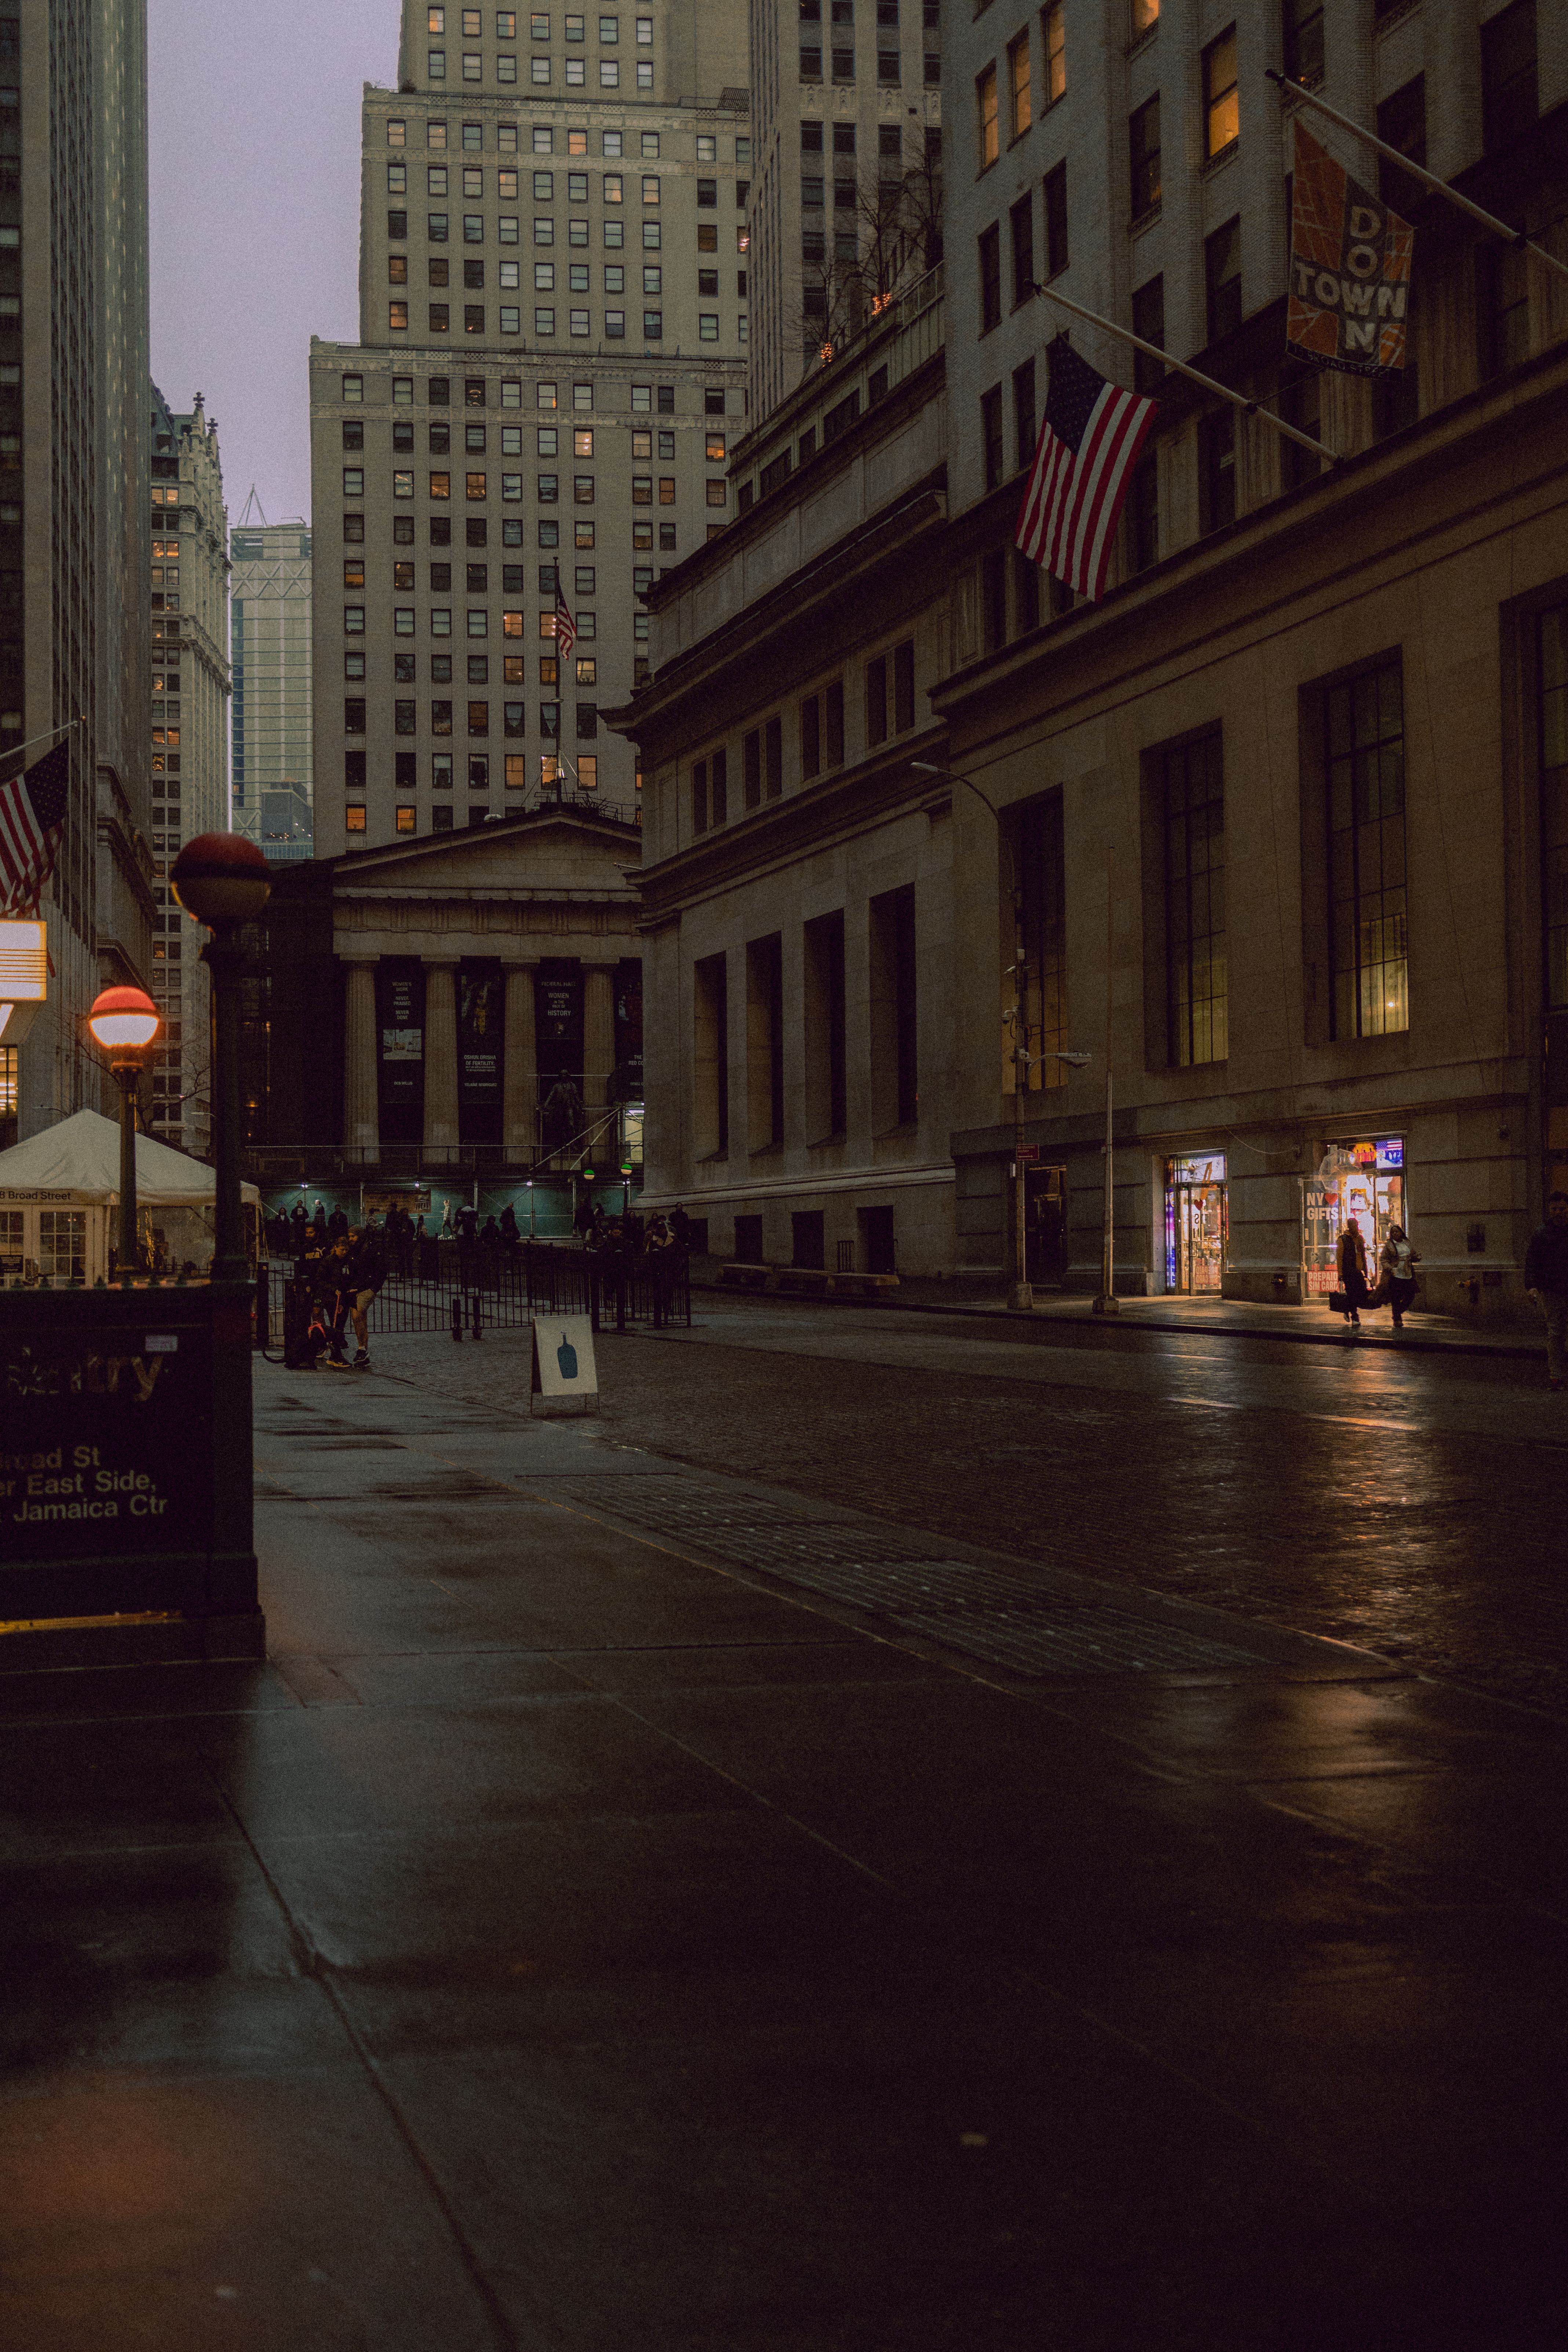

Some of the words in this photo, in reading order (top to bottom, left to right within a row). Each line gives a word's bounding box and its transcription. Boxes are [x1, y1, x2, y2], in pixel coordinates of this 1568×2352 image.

[1295, 261, 1406, 318] TOWN
[1307, 351, 1345, 370] BROAD
[8, 1191, 38, 1199] Broad
[40, 1191, 71, 1200] Street
[1307, 1192, 1324, 1206] NY
[1307, 1207, 1338, 1220] GIFTS
[305, 1252, 321, 1260] PUMA
[1308, 1272, 1338, 1281] PREPAID
[1308, 1281, 1320, 1291] SIM
[1321, 1281, 1338, 1290] CARD
[73, 1445, 101, 1468] St
[27, 1473, 84, 1496] East
[95, 1469, 156, 1493] Side,
[13, 1498, 118, 1523] Jamaica
[130, 1494, 168, 1516] Ctr
